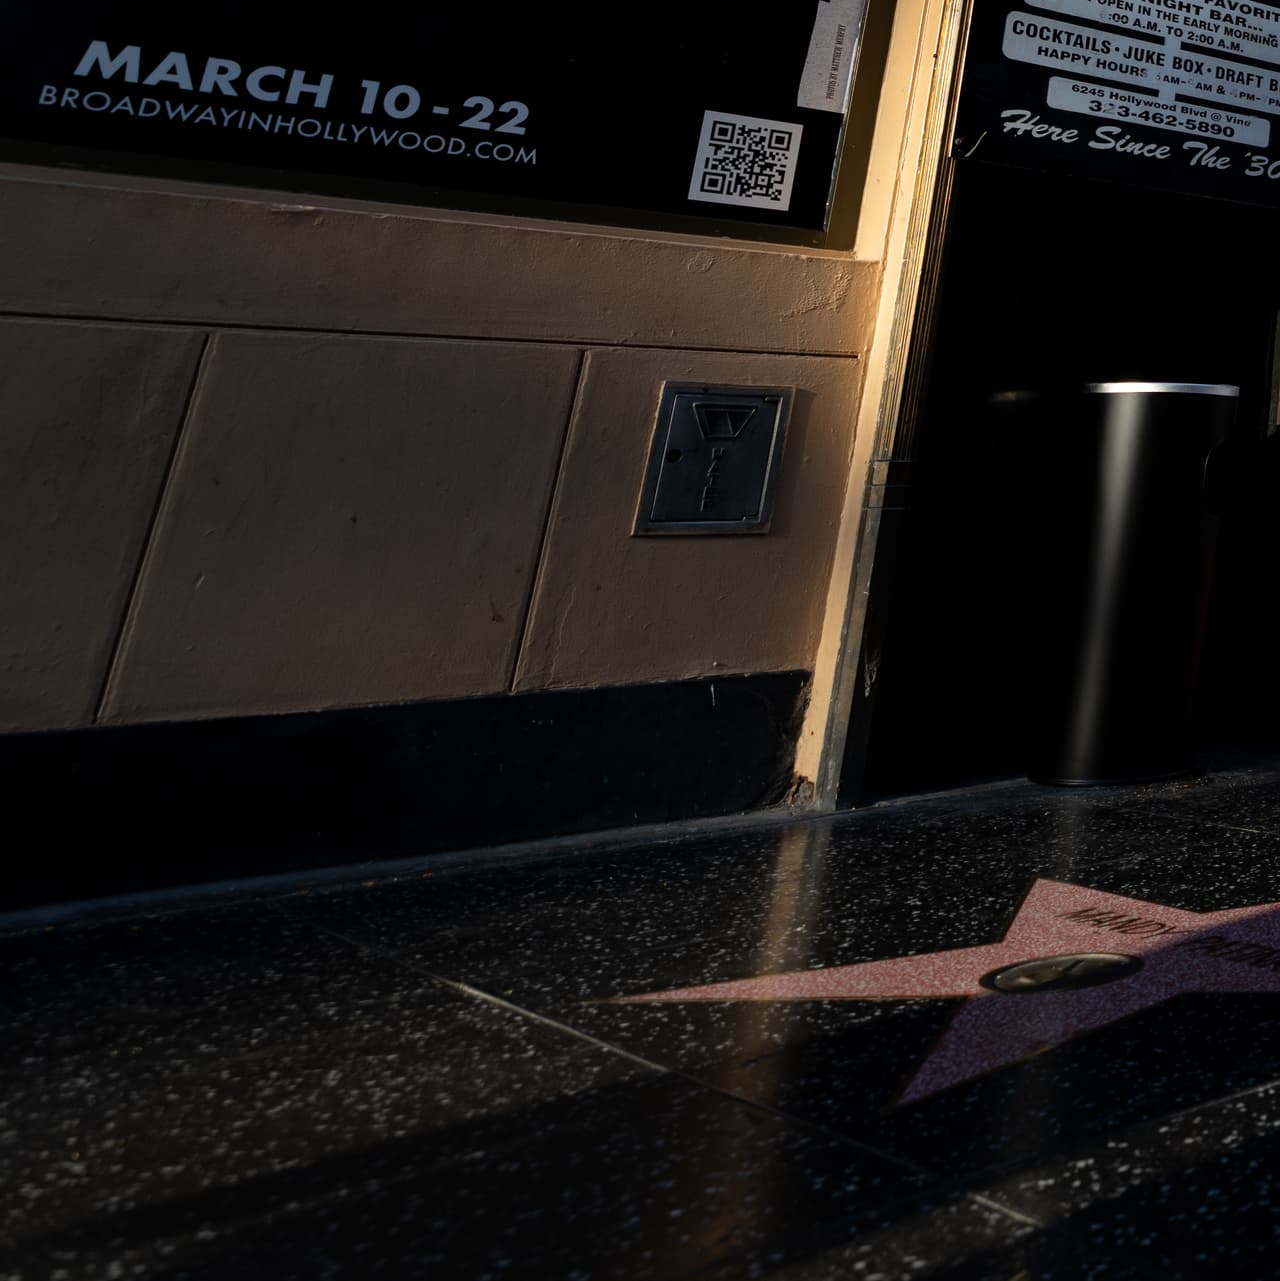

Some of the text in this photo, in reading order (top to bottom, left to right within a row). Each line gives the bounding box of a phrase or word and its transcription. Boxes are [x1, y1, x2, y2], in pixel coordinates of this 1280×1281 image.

[1101, 10, 1245, 54] :00 A.M. TO 2:00 A.M.
[1137, 2, 1152, 18] IN
[1154, 5, 1180, 25] THE
[1183, 12, 1221, 36] EARLY
[1223, 20, 1279, 50] MORNING
[1209, 10, 1264, 33] BAR...
[74, 39, 335, 109] MARCH
[1011, 19, 1112, 55] COCKTAILS
[1122, 42, 1166, 67] JUKE
[1172, 54, 1204, 75] BOX
[1215, 64, 1264, 90] DRAFT
[1037, 45, 1091, 68] HAPPY
[1096, 57, 1148, 80] HOURS
[1216, 82, 1227, 96] &
[38, 83, 539, 167] BROADWAYINHOLLYWOOD.COM
[1071, 83, 1105, 101] 6245
[1108, 90, 1176, 114] Hollywood
[1180, 100, 1208, 118] Blvd
[1210, 108, 1223, 123] @
[999, 107, 1080, 144] Here
[1088, 124, 1171, 160] Since
[1182, 139, 1234, 172] The
[1055, 909, 1192, 940] MANDY
